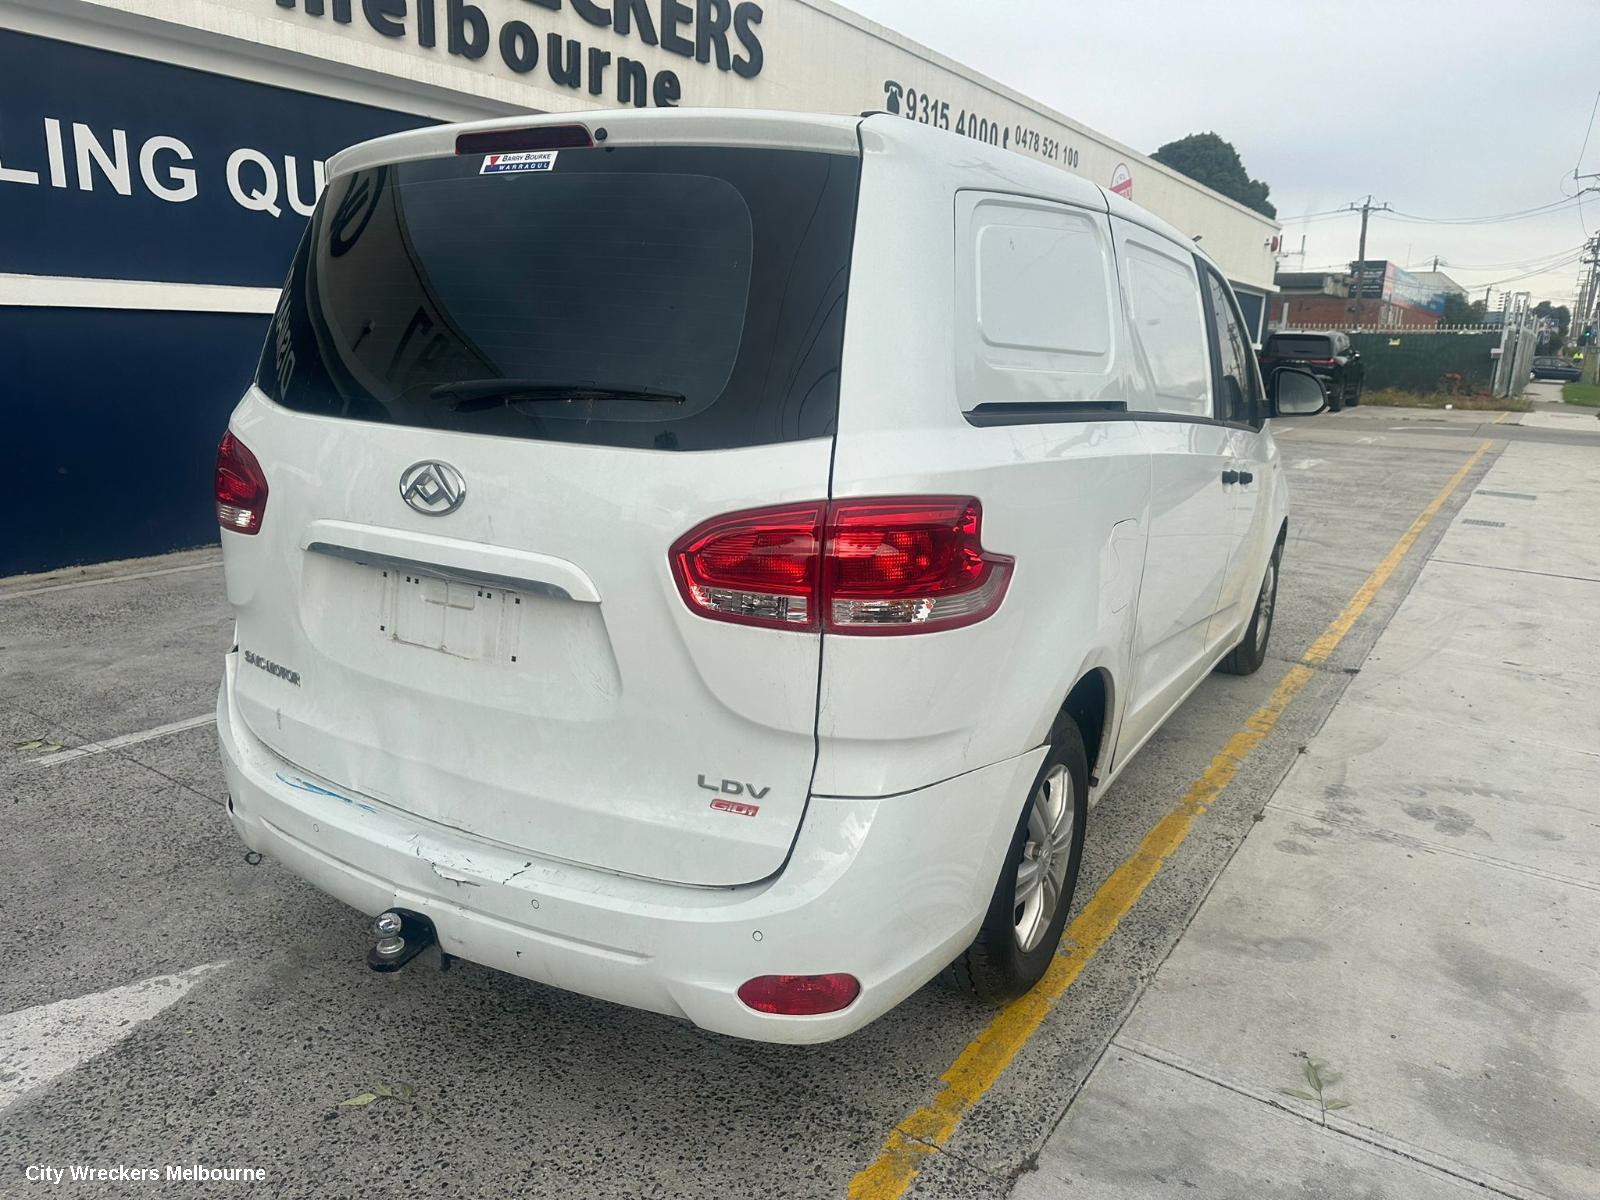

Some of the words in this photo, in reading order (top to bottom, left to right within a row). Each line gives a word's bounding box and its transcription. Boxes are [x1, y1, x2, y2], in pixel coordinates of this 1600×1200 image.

[518, 0, 763, 79] KERS
[906, 88, 949, 131] 9315
[955, 109, 998, 147] 4000
[502, 154, 523, 162] BARRY
[524, 153, 552, 161] BOURKE
[1015, 125, 1040, 152] 0478
[1042, 136, 1059, 160] 521
[1063, 145, 1079, 168] 100
[499, 162, 548, 170] WARRAGUL
[697, 774, 771, 799] LDV
